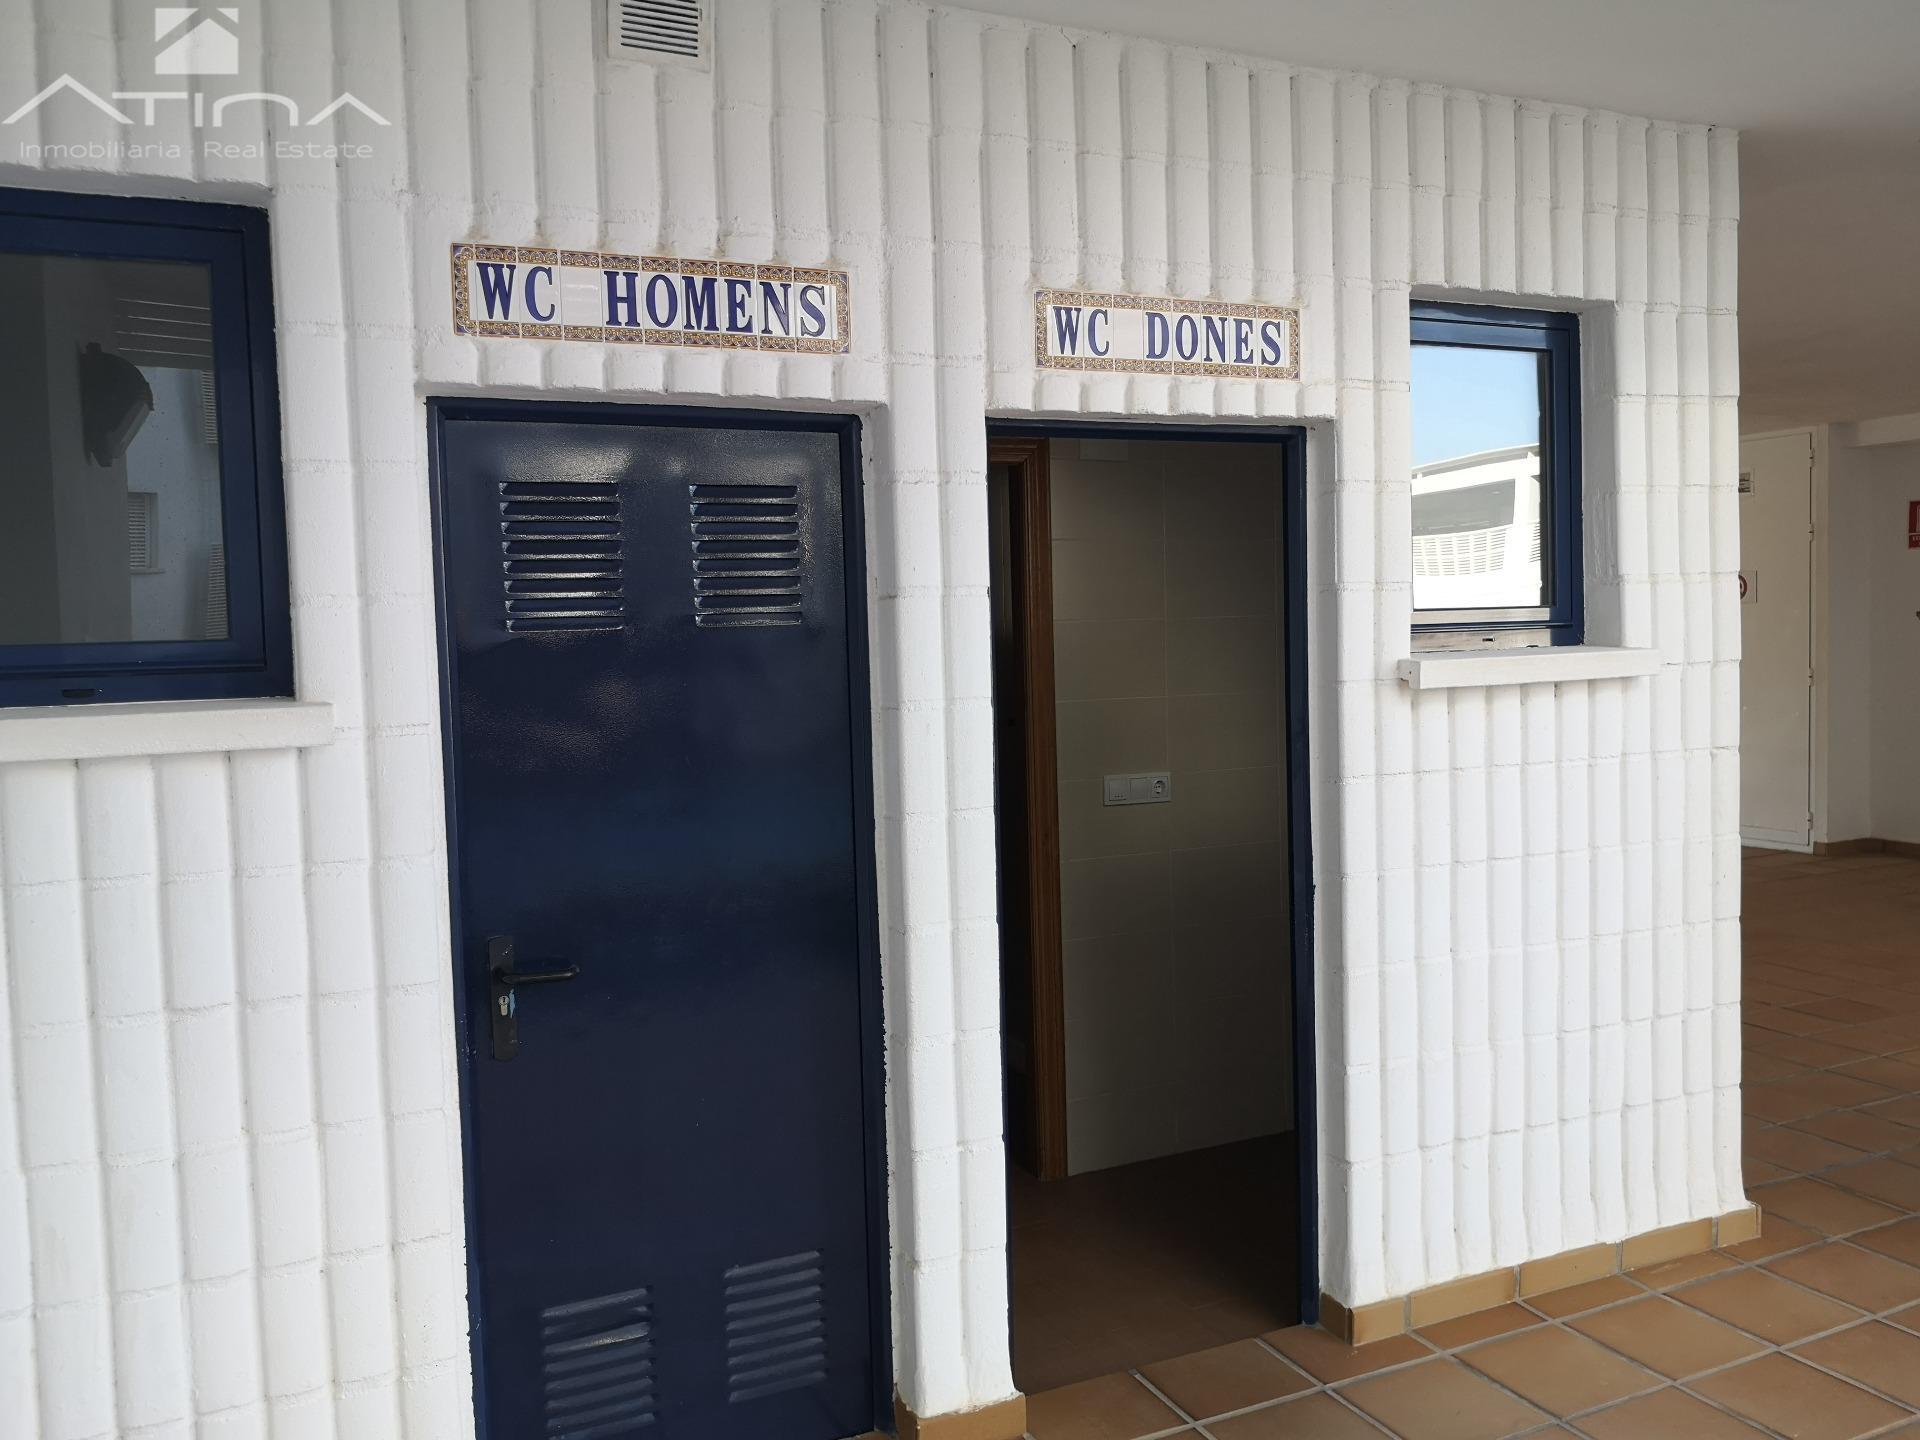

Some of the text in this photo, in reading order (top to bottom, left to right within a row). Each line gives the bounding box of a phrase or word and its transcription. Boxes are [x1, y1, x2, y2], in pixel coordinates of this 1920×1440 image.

[476, 262, 828, 338] WC HOMENS
[1053, 305, 1282, 366] WC DONES
